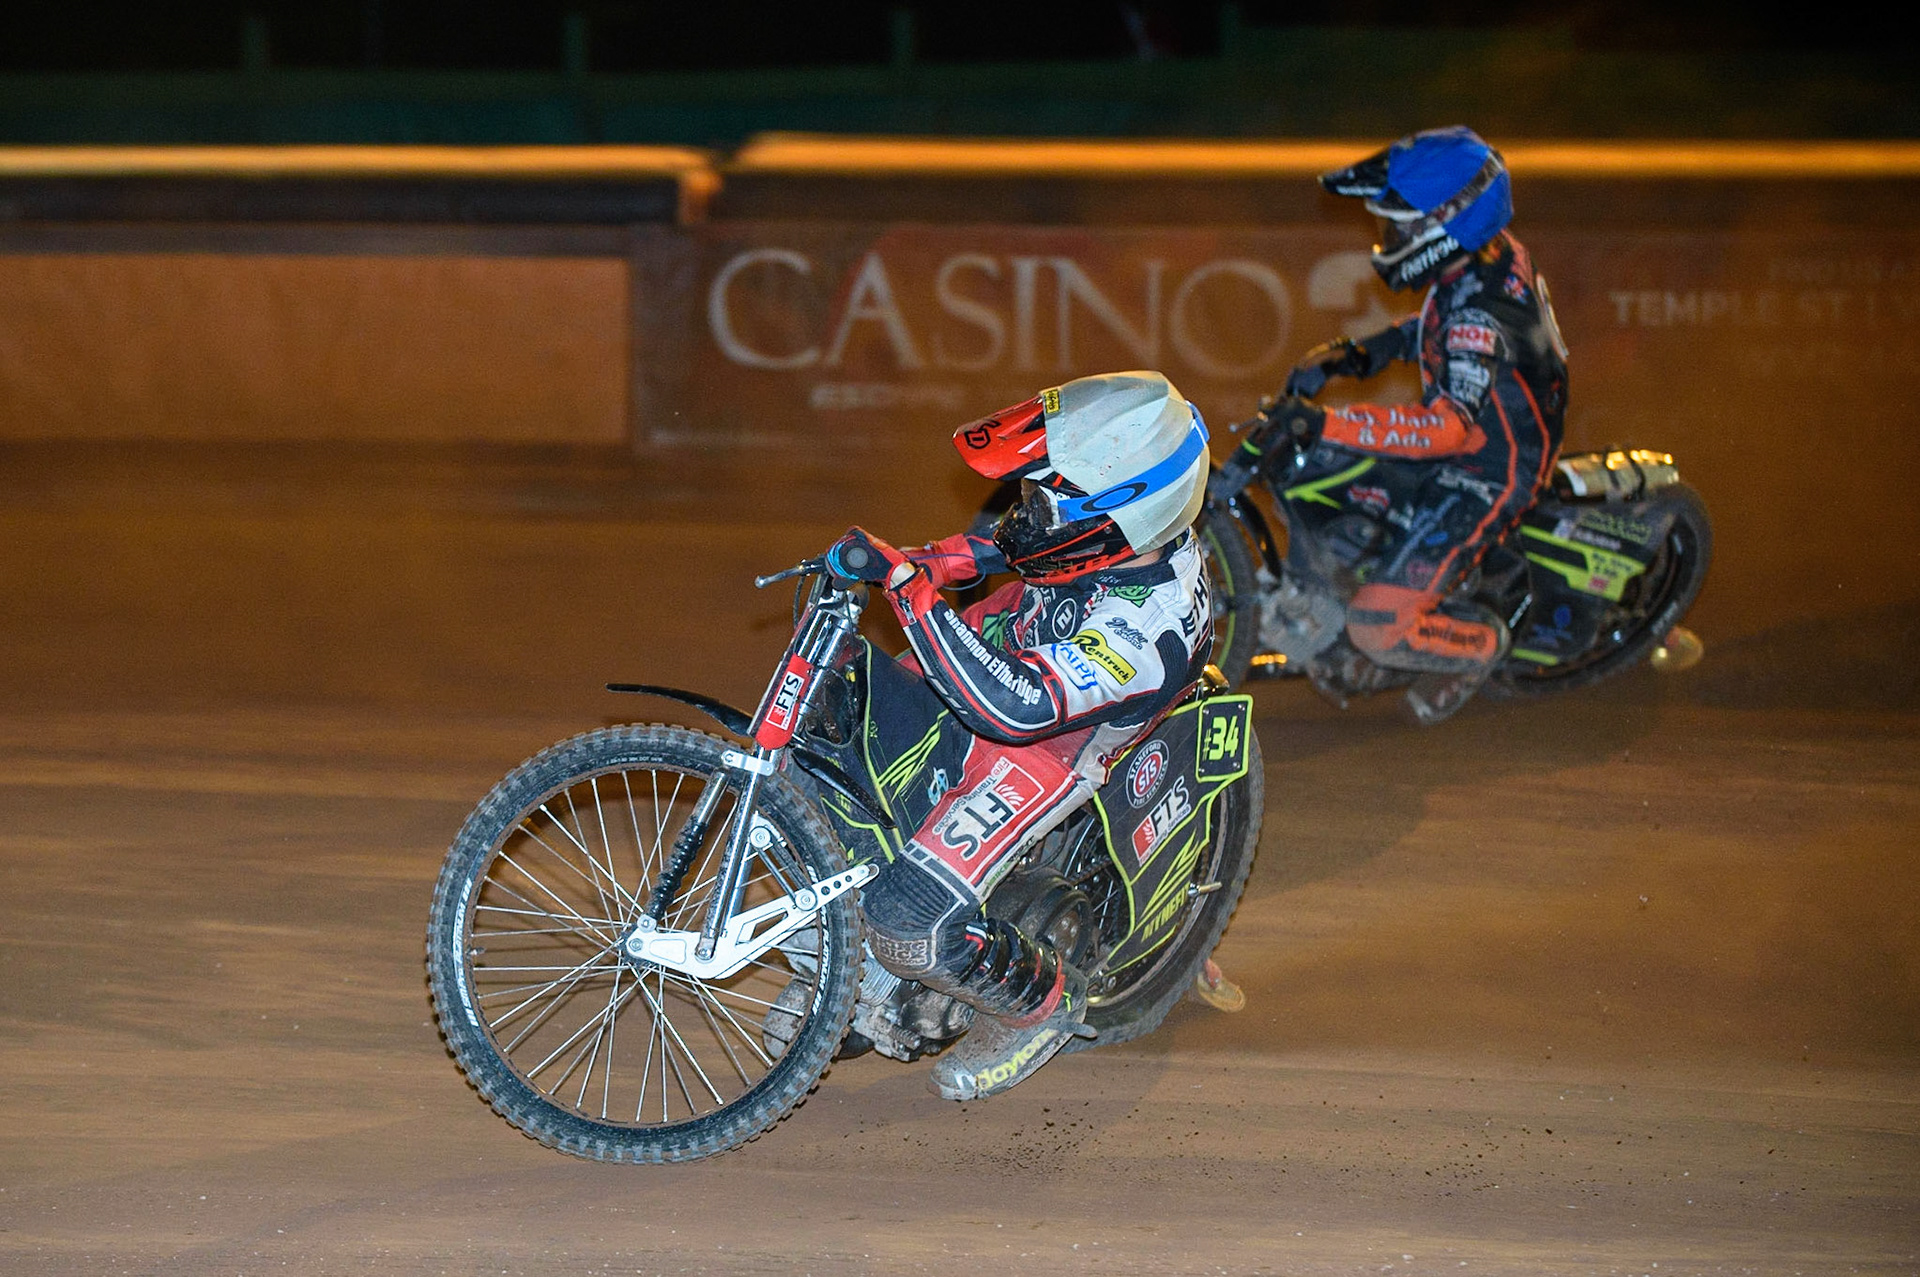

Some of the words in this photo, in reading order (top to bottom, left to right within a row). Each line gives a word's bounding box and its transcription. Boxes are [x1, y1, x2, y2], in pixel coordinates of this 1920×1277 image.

[707, 247, 1293, 378] CASINO
[1608, 290, 1780, 325] TEMPLE
[943, 608, 992, 667] Shannon
[986, 656, 1042, 706] Etheridge
[1074, 633, 1130, 681] Rentruck
[775, 674, 800, 711] FTS
[1202, 715, 1239, 761] #34
[963, 776, 998, 802] Training
[993, 758, 1010, 776] Fire
[1138, 757, 1158, 794] STS
[934, 797, 966, 832] Services
[943, 791, 1015, 859] FTS
[1150, 778, 1189, 838] FTS
[819, 927, 830, 991] PLATINUM
